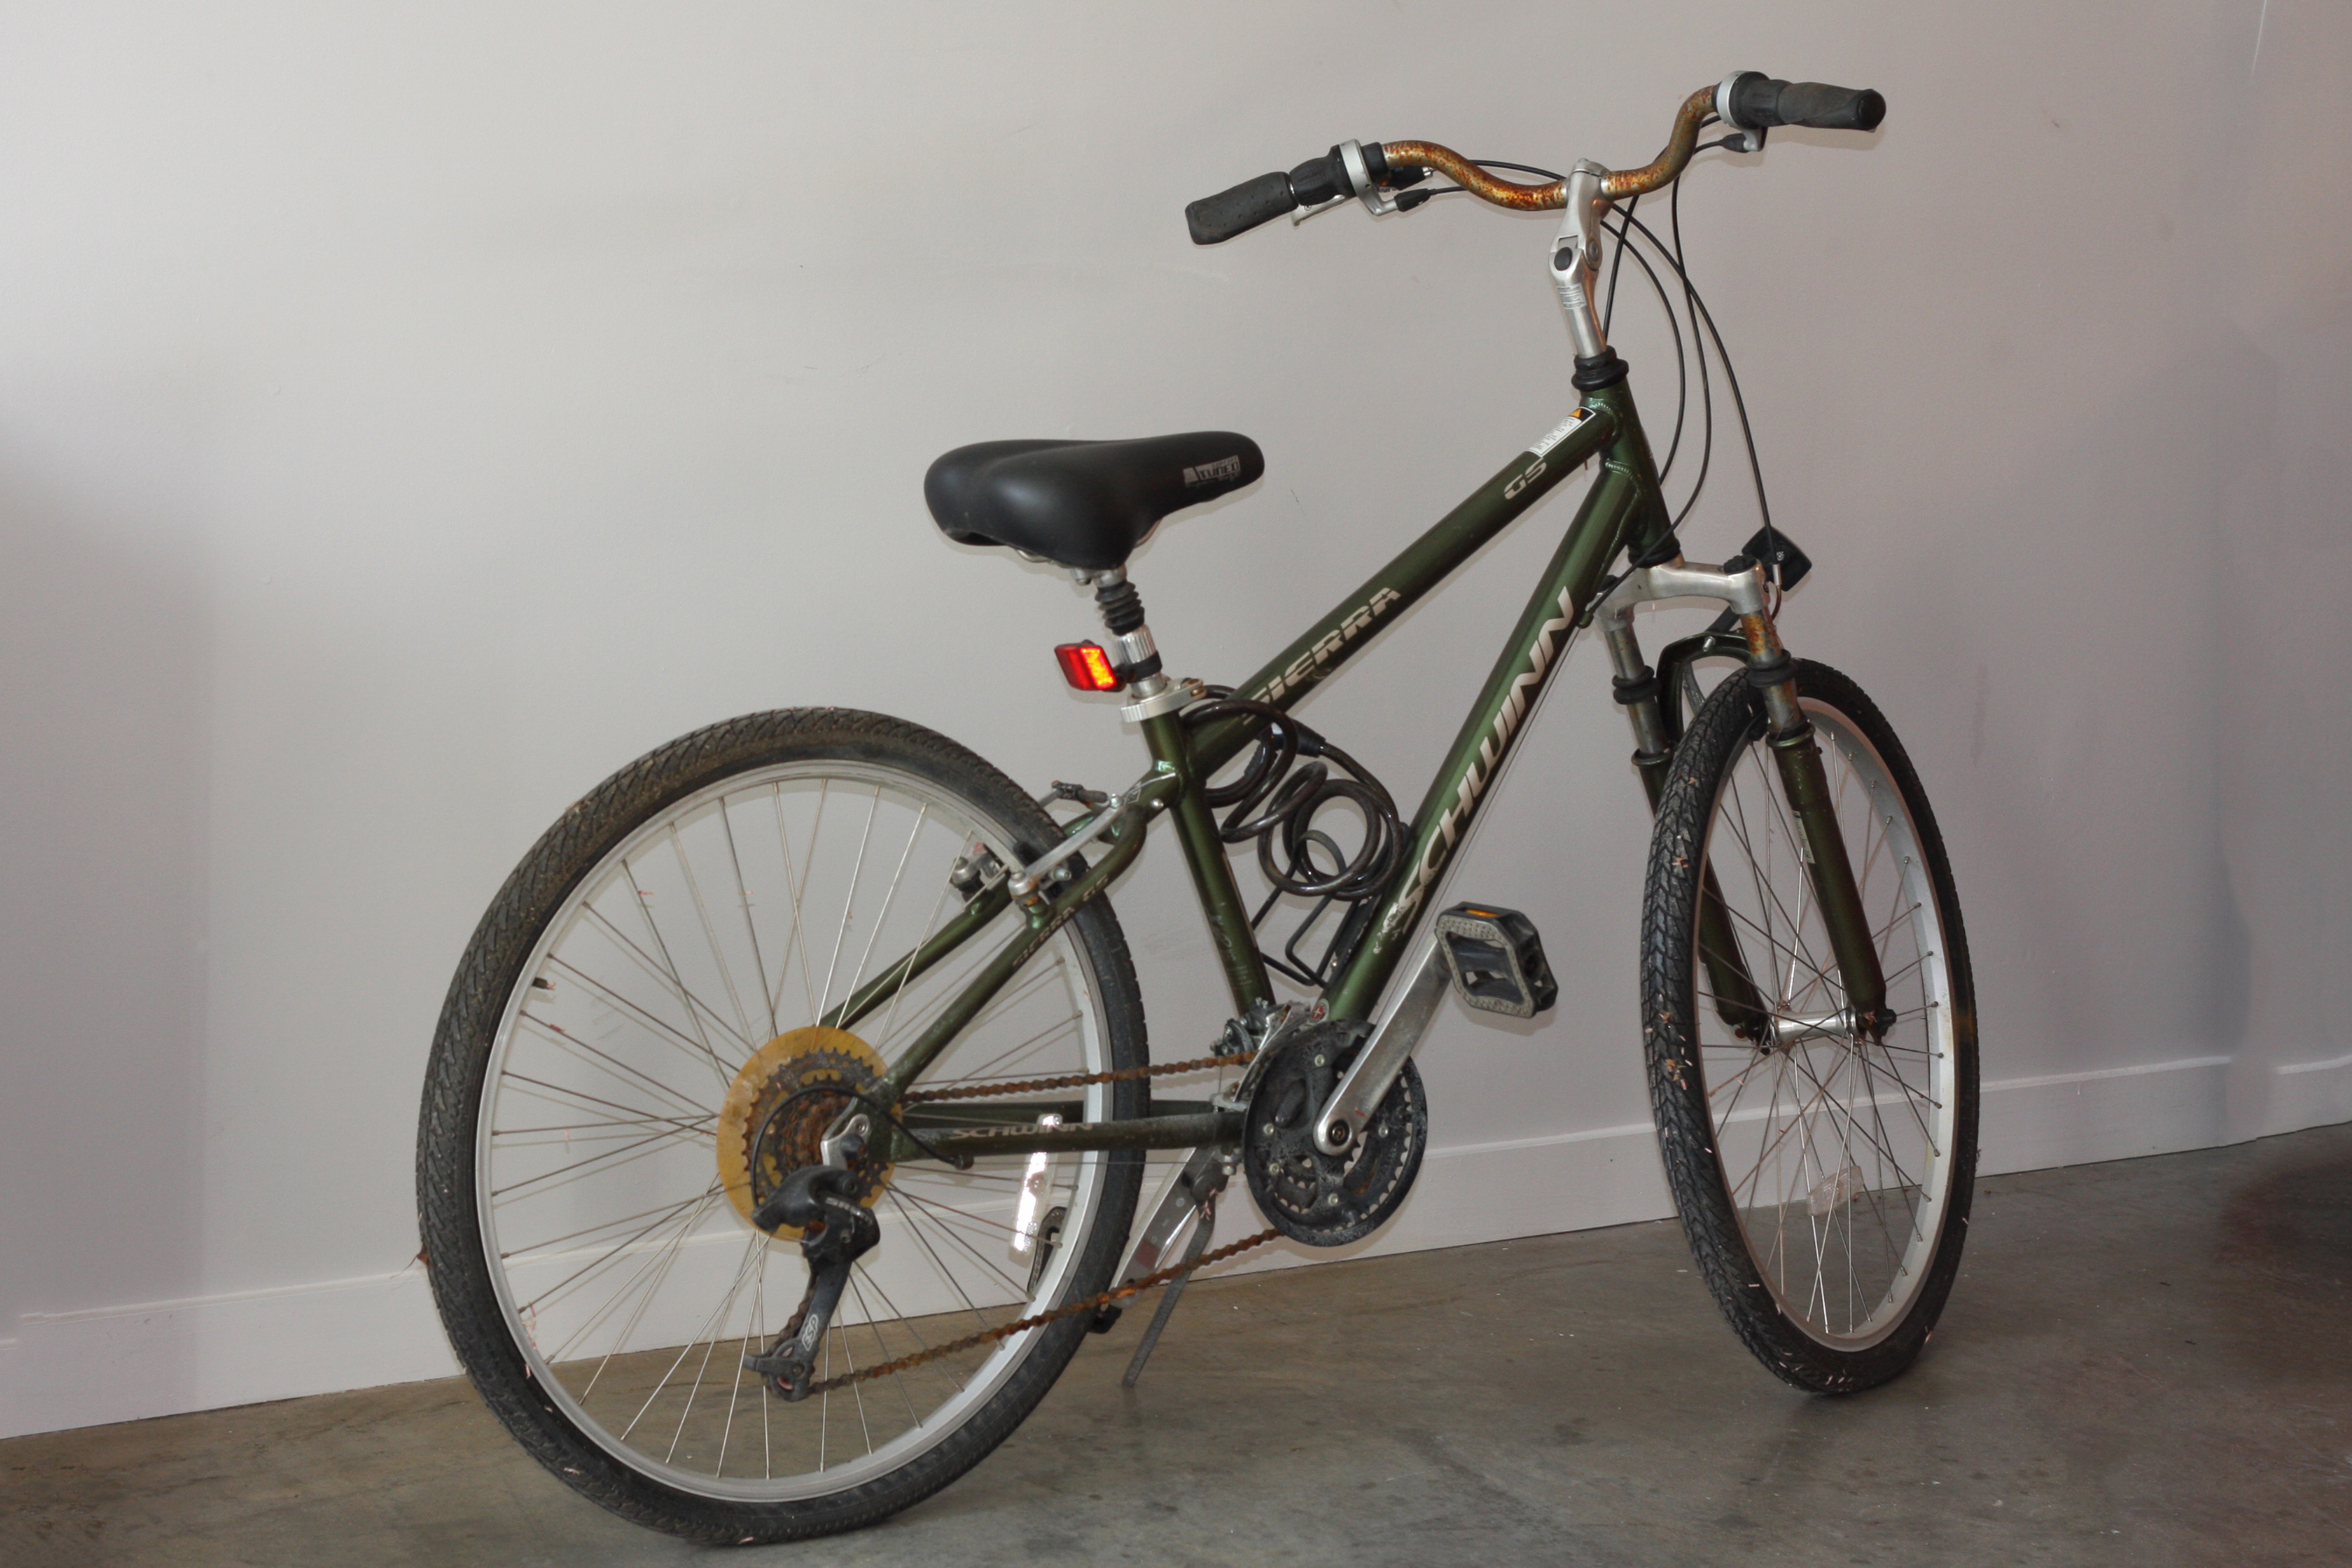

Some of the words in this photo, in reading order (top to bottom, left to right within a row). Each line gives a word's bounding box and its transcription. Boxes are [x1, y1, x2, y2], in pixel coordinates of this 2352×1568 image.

[1503, 457, 1547, 500] GS
[949, 1121, 1094, 1141] SCHWINN
[801, 1313, 819, 1352] ESP
